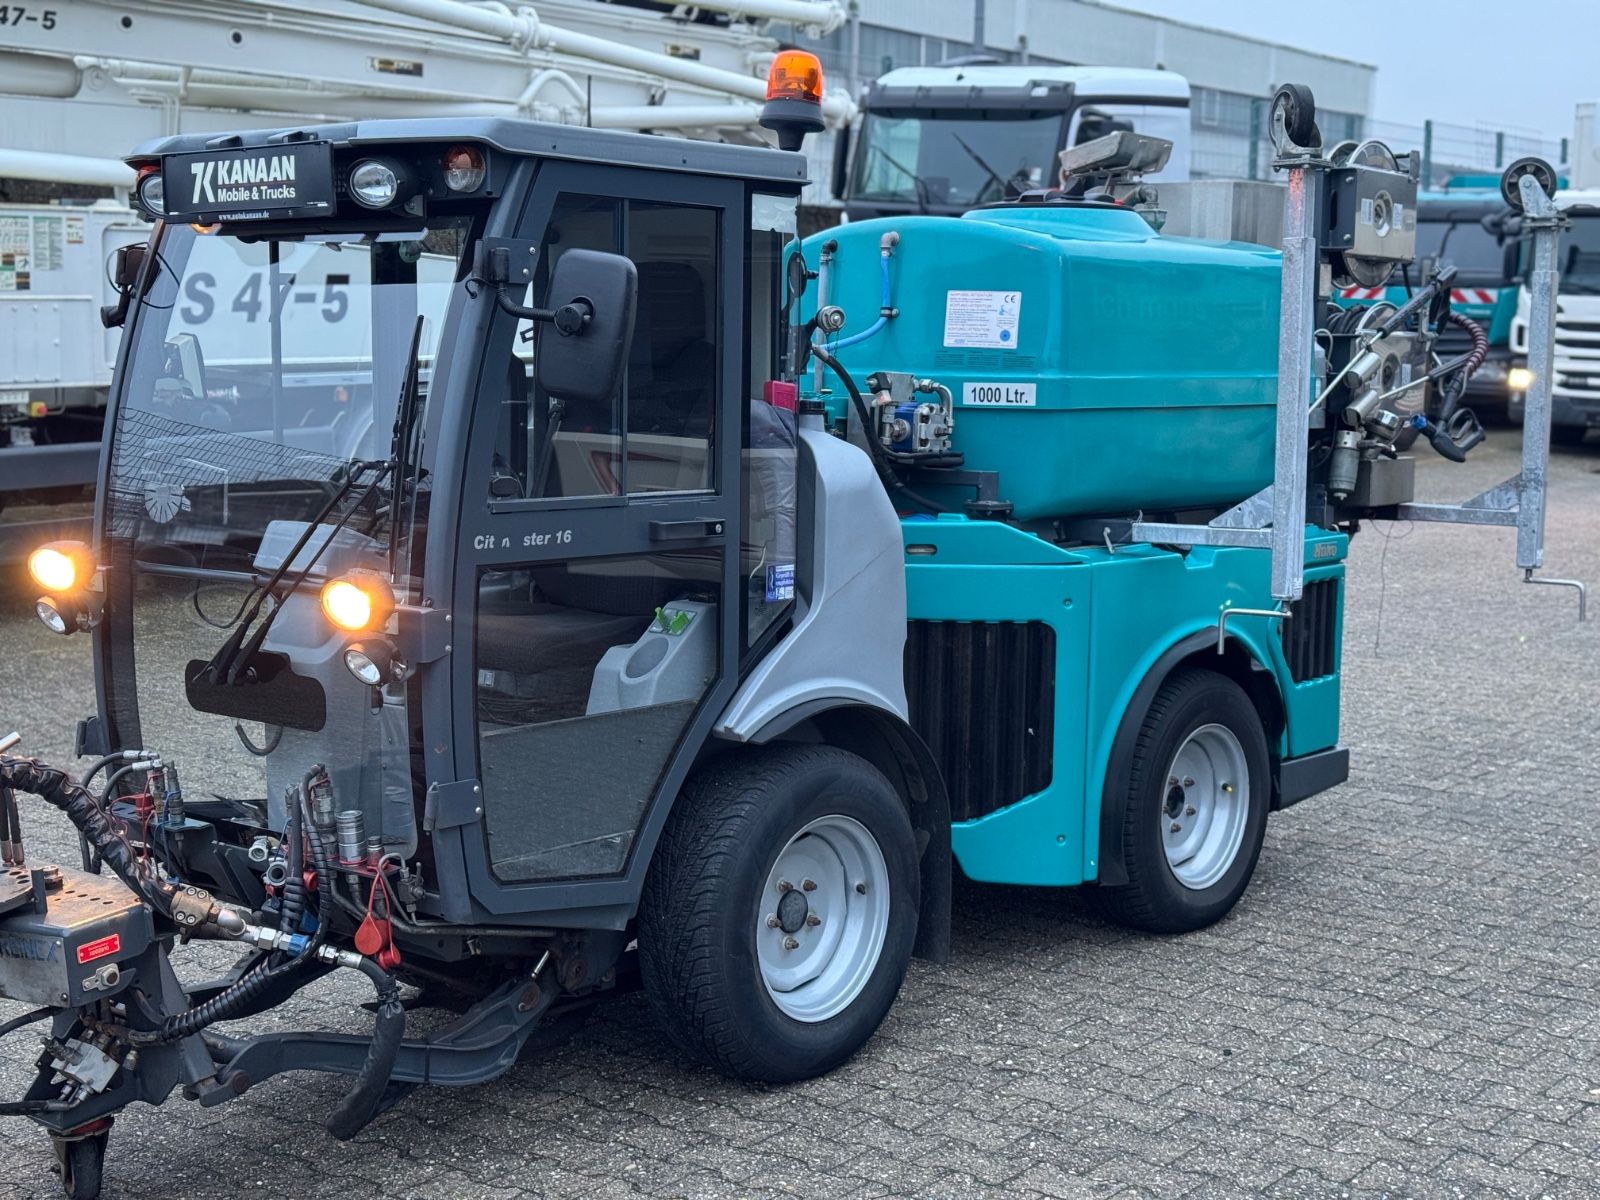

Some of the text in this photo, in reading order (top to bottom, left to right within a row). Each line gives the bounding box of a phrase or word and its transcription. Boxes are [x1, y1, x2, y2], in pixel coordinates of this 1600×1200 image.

[218, 155, 296, 185] KANAAN
[217, 184, 296, 203] Mobile & Trucks
[218, 210, 270, 220] www.autokanaan.de
[180, 272, 217, 326] S
[971, 387, 1028, 403] 1000 Ltr.
[556, 529, 573, 544] 16
